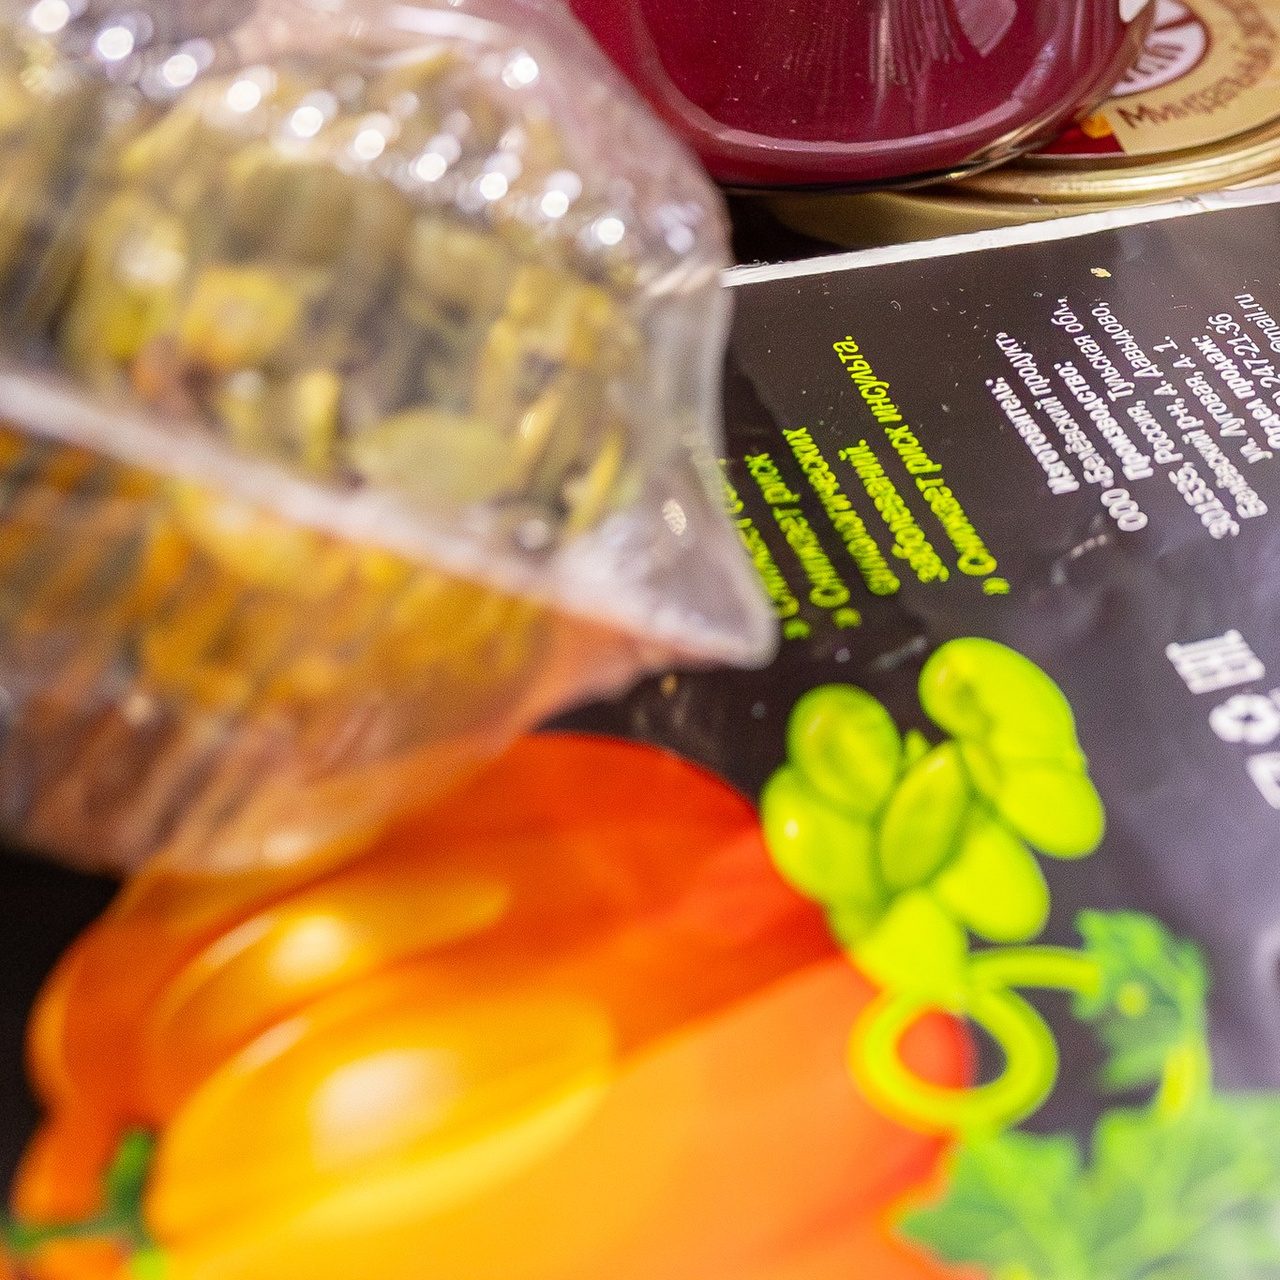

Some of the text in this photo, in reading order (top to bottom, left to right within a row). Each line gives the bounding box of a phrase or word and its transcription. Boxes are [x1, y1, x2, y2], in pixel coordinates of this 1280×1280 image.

[996, 332, 1051, 396] продукт»
[1074, 335, 1135, 402] Тульская
[1092, 303, 1164, 377] Давыдово,
[1191, 335, 1255, 399] продаж:
[986, 377, 1079, 494] Изготовитель:
[1054, 361, 1154, 480] Производство:
[1127, 401, 1183, 464] Россия,
[1186, 371, 1247, 436] Луговая,
[833, 336, 997, 575] Снижает риск инсульта.
[1101, 489, 1148, 531] ООО
